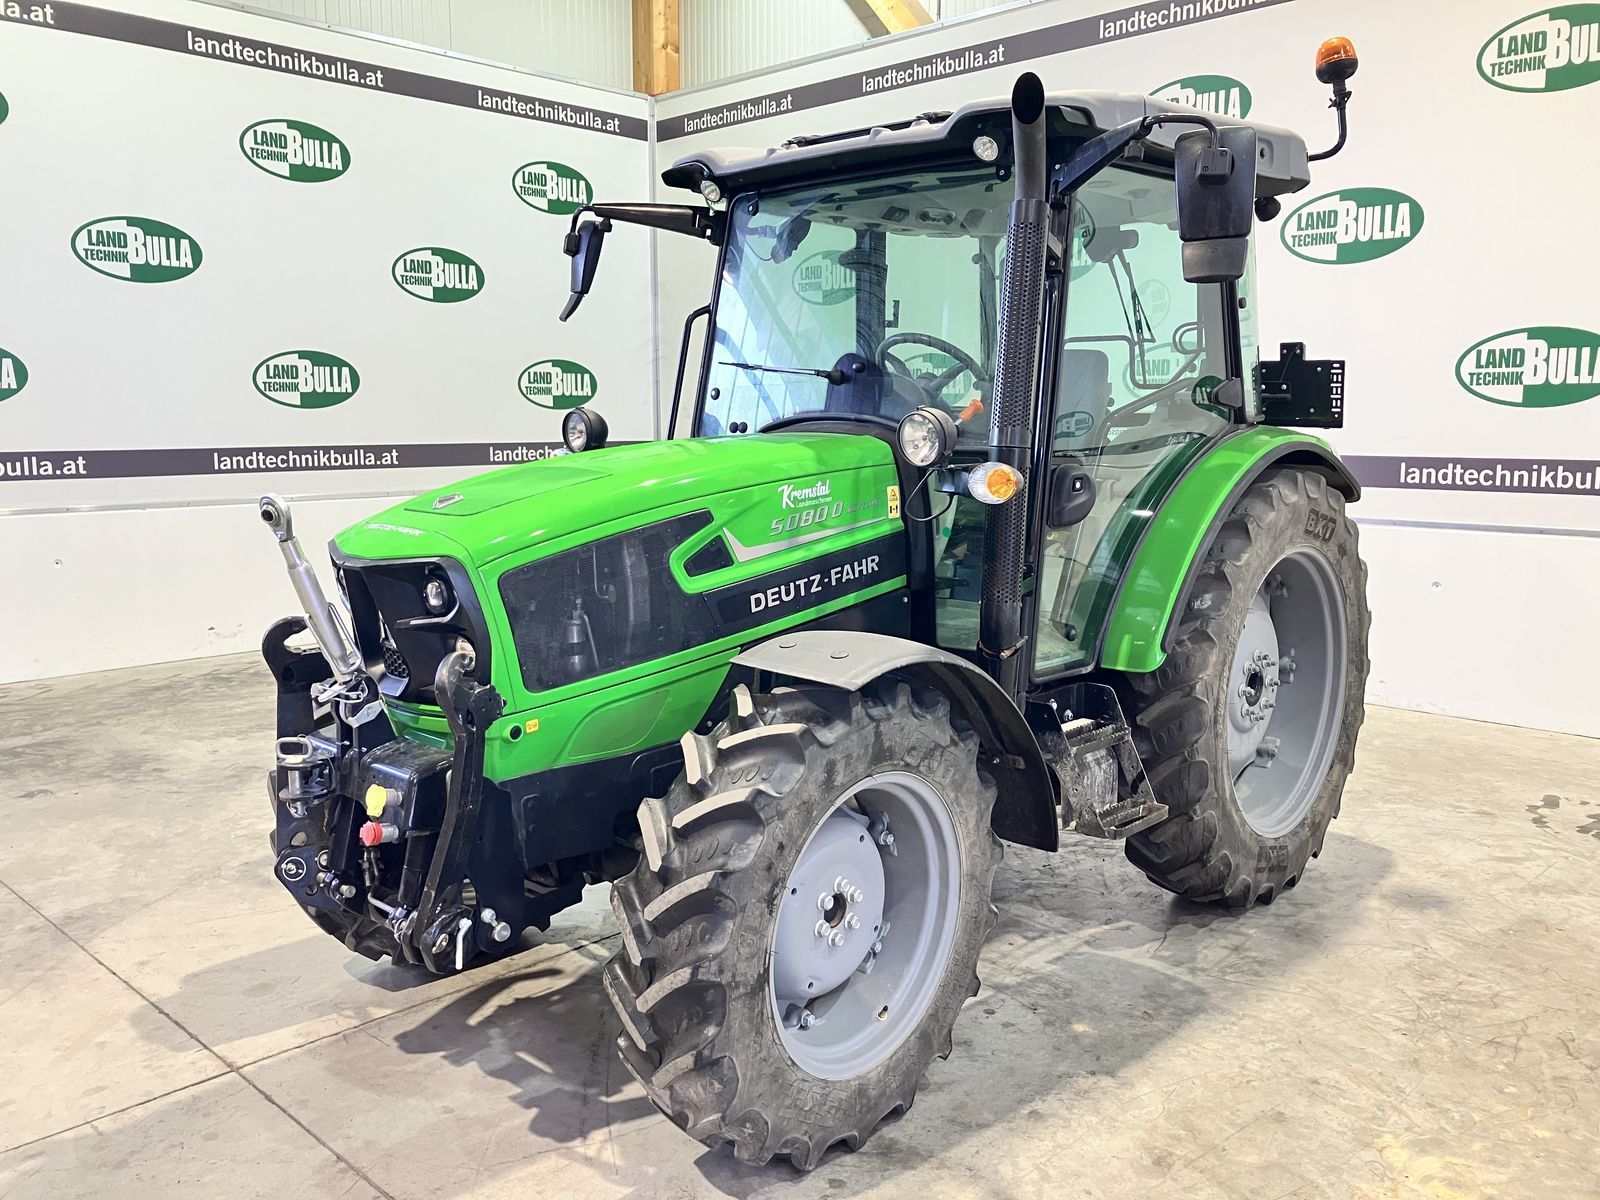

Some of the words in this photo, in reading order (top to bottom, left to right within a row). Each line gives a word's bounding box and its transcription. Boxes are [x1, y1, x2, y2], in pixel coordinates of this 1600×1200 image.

[1099, 0, 1268, 39] landtechnikbu
[1497, 30, 1548, 58] LAND
[187, 31, 384, 87] landtechnikbulla.at
[862, 44, 1005, 93] landtechnikbulla.at
[1490, 54, 1546, 77] TECHNIK
[478, 90, 620, 133] landtechnikbulla.at
[684, 94, 792, 133] landtechnikbulla.at
[253, 129, 288, 149] LAND
[287, 128, 343, 170] BULLA
[249, 147, 289, 163] TECHNIK
[522, 170, 547, 187] LAND
[546, 168, 588, 204] BULLA
[519, 185, 548, 199] TECHNIK
[1297, 209, 1338, 232] LAND
[1337, 200, 1411, 244] BULLA
[86, 228, 128, 249] LAND
[127, 226, 194, 268] BULLA
[1291, 231, 1338, 248] TECHNIK
[83, 248, 129, 263] TECHNIK
[403, 258, 432, 275] LAND
[400, 274, 433, 287] TECHNIK
[431, 255, 478, 290] BULLA
[821, 259, 857, 290] BULL
[1475, 347, 1525, 369] LAND
[266, 364, 299, 379] LAND
[298, 358, 352, 392] BULLA
[527, 371, 552, 385] LAND
[551, 366, 592, 396] BULLA
[1468, 371, 1525, 386] TECHNIK
[262, 381, 300, 392] TECHNIK
[525, 386, 552, 396] TECHNIK
[213, 449, 399, 470] landtechnikbulla.at
[489, 445, 553, 462] landtech
[778, 479, 831, 509] Kremstal
[769, 505, 829, 536] 5080
[1305, 510, 1337, 541] BKT
[750, 555, 880, 613] DEUTZ-FAHR
